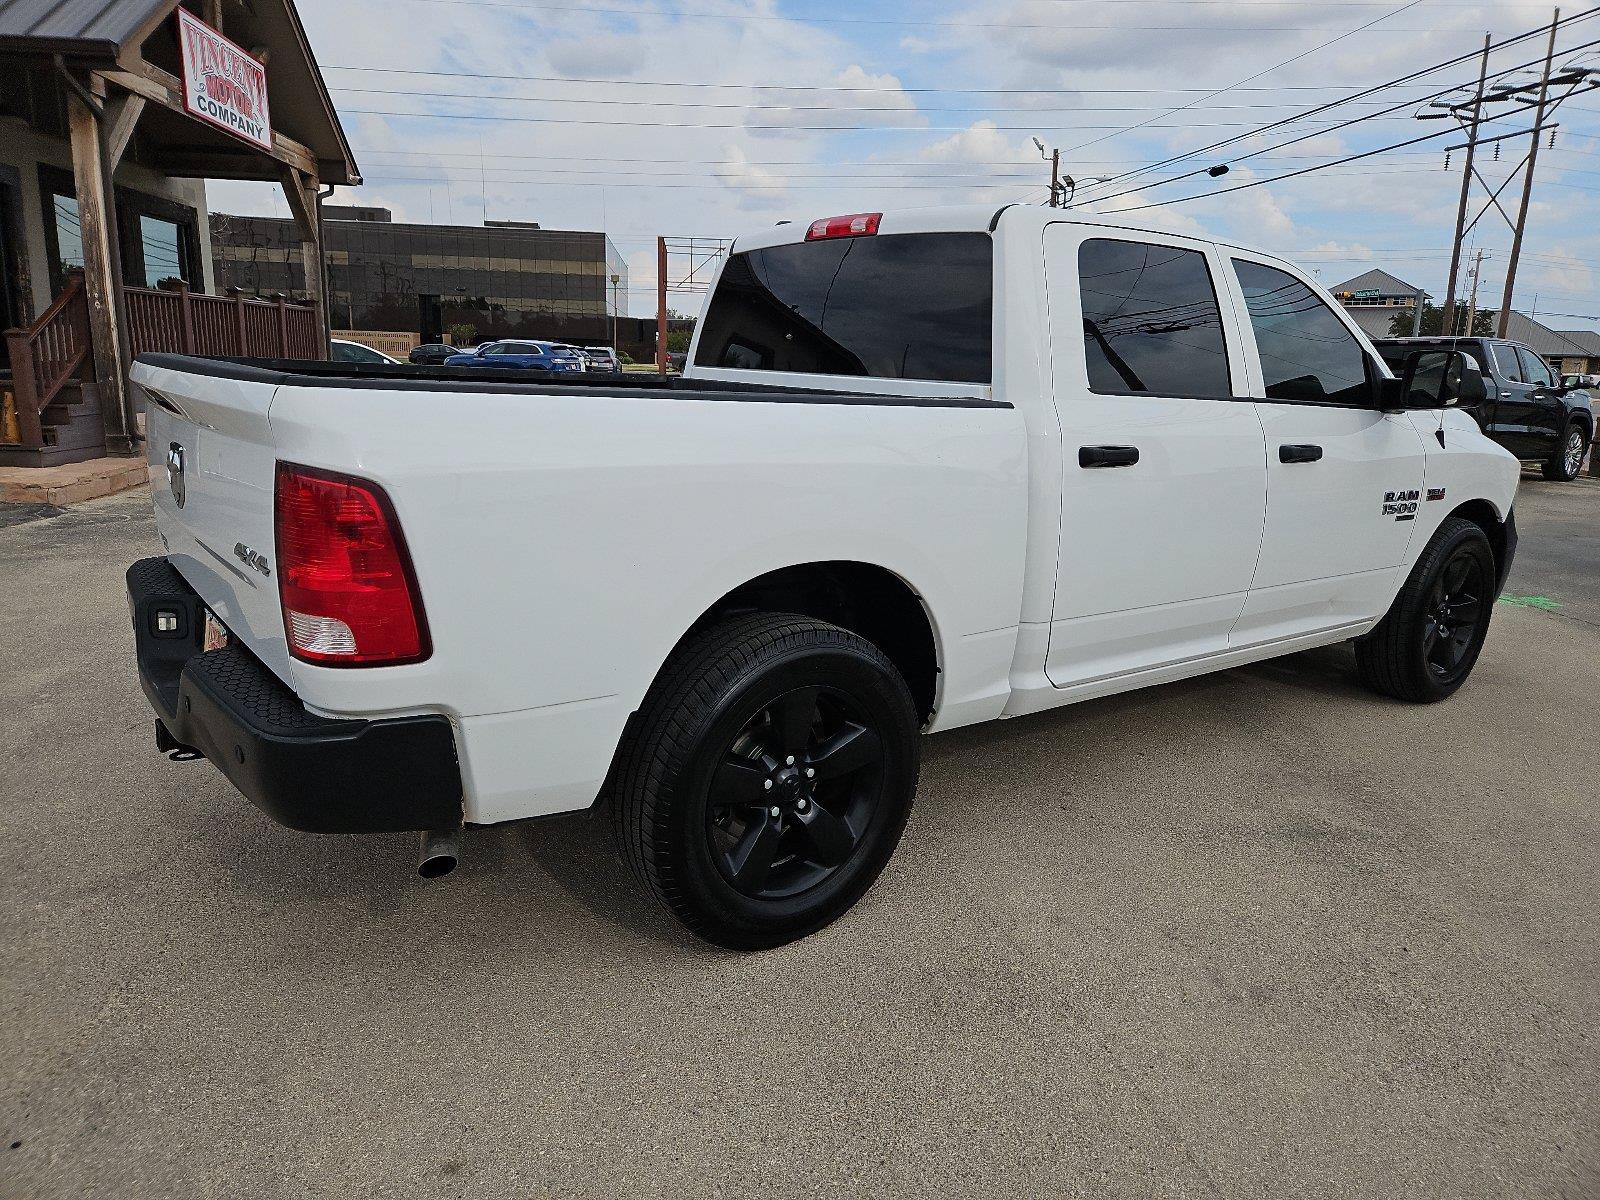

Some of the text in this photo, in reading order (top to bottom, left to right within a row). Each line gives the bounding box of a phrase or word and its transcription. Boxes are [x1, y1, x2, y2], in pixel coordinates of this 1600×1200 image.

[182, 21, 266, 123] VINCENT
[196, 94, 264, 140] COMPANY
[204, 74, 254, 120] MOTOR
[1381, 502, 1418, 515] 1500
[1383, 490, 1420, 502] RAM
